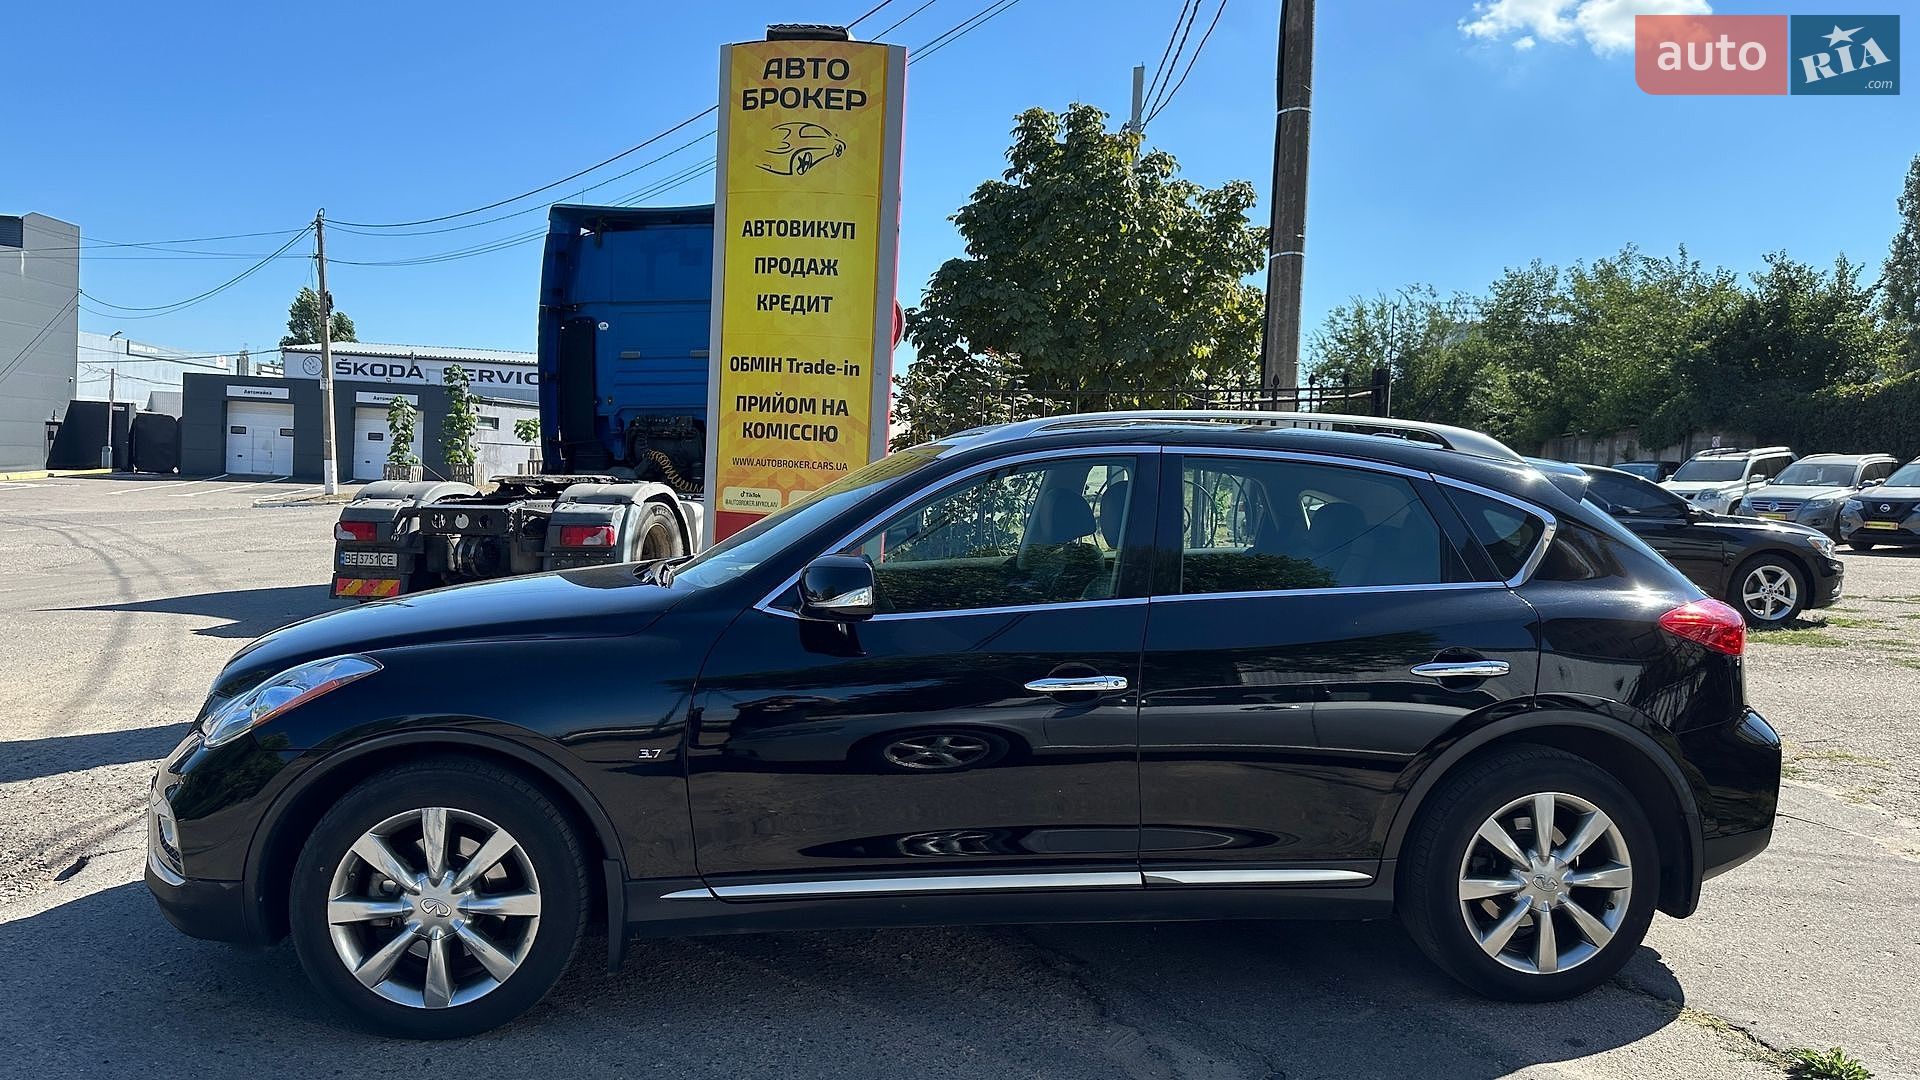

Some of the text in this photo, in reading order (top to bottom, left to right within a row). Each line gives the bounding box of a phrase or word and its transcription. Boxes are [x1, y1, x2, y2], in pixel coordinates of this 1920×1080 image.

[763, 57, 850, 81] АВТО
[742, 86, 867, 111] БРОКЕР
[741, 219, 856, 240] АВТОВИКУП
[754, 257, 839, 278] ПРОДАЖ
[756, 294, 833, 315] КРЕДИТ
[335, 358, 424, 379] ŠKODA
[729, 356, 860, 377] ОБМІН Trade-in
[735, 392, 849, 417] ПРИЙОМ НА
[742, 422, 839, 443] КОМІССІЮ
[732, 457, 848, 471] WWW.AUTOBROKER.CARS.UA
[359, 554, 379, 565] 3751
